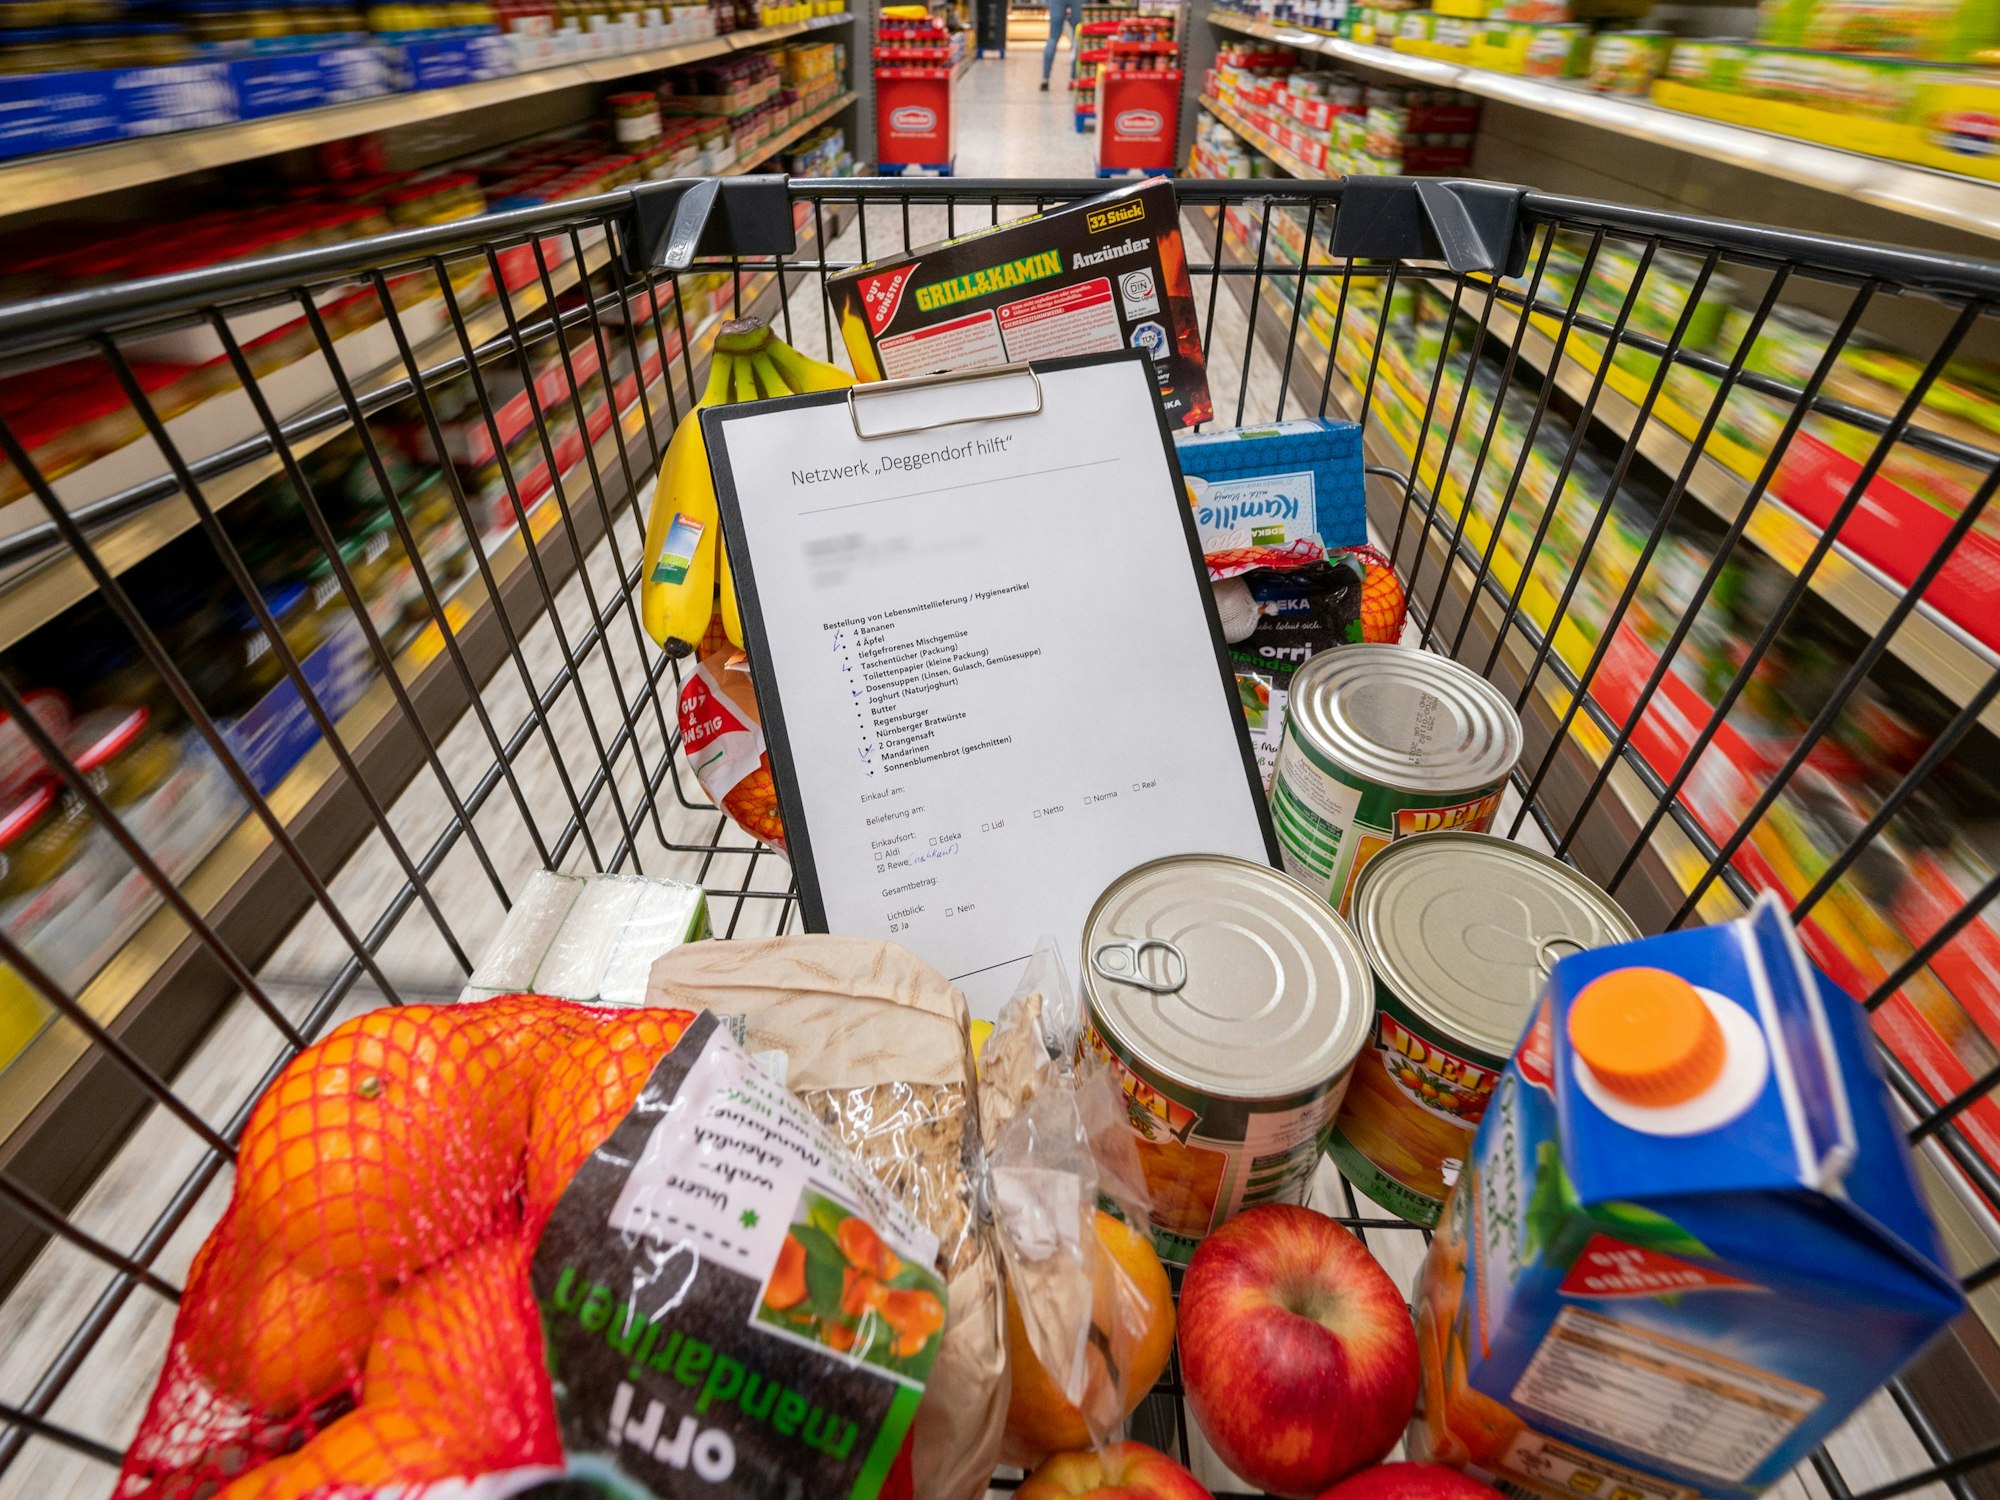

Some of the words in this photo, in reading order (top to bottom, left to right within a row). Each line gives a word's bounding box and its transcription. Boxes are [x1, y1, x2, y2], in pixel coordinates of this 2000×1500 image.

[1090, 215, 1107, 230] 32
[1107, 204, 1142, 223] Stück
[1072, 237, 1150, 270] Anzünder
[866, 279, 881, 302] GUT
[917, 250, 1061, 311] GRILL&KAMIN
[1130, 281, 1147, 293] DIN
[875, 274, 902, 322] GÜNSTIG
[876, 291, 886, 300] &
[1141, 331, 1157, 345] TÜV
[791, 460, 870, 486] Netzwerk
[874, 441, 974, 476] „Deggendorf
[1199, 494, 1299, 531] Kamille
[823, 617, 866, 631] Bestellung
[867, 614, 883, 622] von
[884, 596, 968, 618] Lebensmittellieferung
[975, 582, 1030, 600] Hygieneartikel
[861, 623, 895, 635] Bananen
[864, 635, 885, 647] Äpfel
[858, 642, 915, 659] tiefgefrorenes
[916, 630, 968, 646] Mischgemüse
[861, 652, 918, 670] Taschentücher
[920, 643, 958, 658] (Packung)
[1259, 642, 1312, 662] orri
[926, 656, 952, 668] (kleine
[953, 647, 989, 662] Packung)
[866, 676, 920, 693] Dosensuppen
[921, 668, 951, 681] (Linsen,
[953, 660, 985, 673] Gulasch,
[986, 647, 1042, 666] Gemüsesuppe)
[869, 691, 900, 705] Joghurt
[901, 678, 959, 698] (Naturjoghurt)
[871, 704, 897, 716] Butter
[873, 709, 929, 727] Regensburger
[876, 722, 923, 739] Nürnberger
[925, 711, 967, 727] Bratwürste
[879, 742, 884, 750] 2
[886, 730, 935, 748] Orangensaft
[881, 745, 930, 761] Mandarinen
[884, 748, 960, 773] Sonnenblumenbrot
[962, 735, 1013, 755] (geschnitten)
[861, 789, 889, 803] Einkauf
[890, 786, 906, 796] am:
[866, 810, 910, 827] Belieferung
[911, 805, 926, 815] am:
[885, 847, 901, 859] Aldi
[939, 831, 962, 844] Edeka
[991, 819, 1005, 831] Lidl
[1043, 804, 1064, 817] Netto
[1093, 790, 1118, 803] Norma
[1141, 779, 1157, 791] Real
[871, 831, 917, 850] Einkaufsort:
[887, 858, 909, 870] Rewe
[882, 877, 938, 897] Gesamtbetrag:
[887, 903, 926, 921] Lichtblick:
[900, 920, 910, 931] Ja
[957, 902, 976, 915] Nein
[666, 1175, 728, 1210] Unsere
[553, 1265, 861, 1461] mandarinen
[607, 1380, 737, 1483] orri
